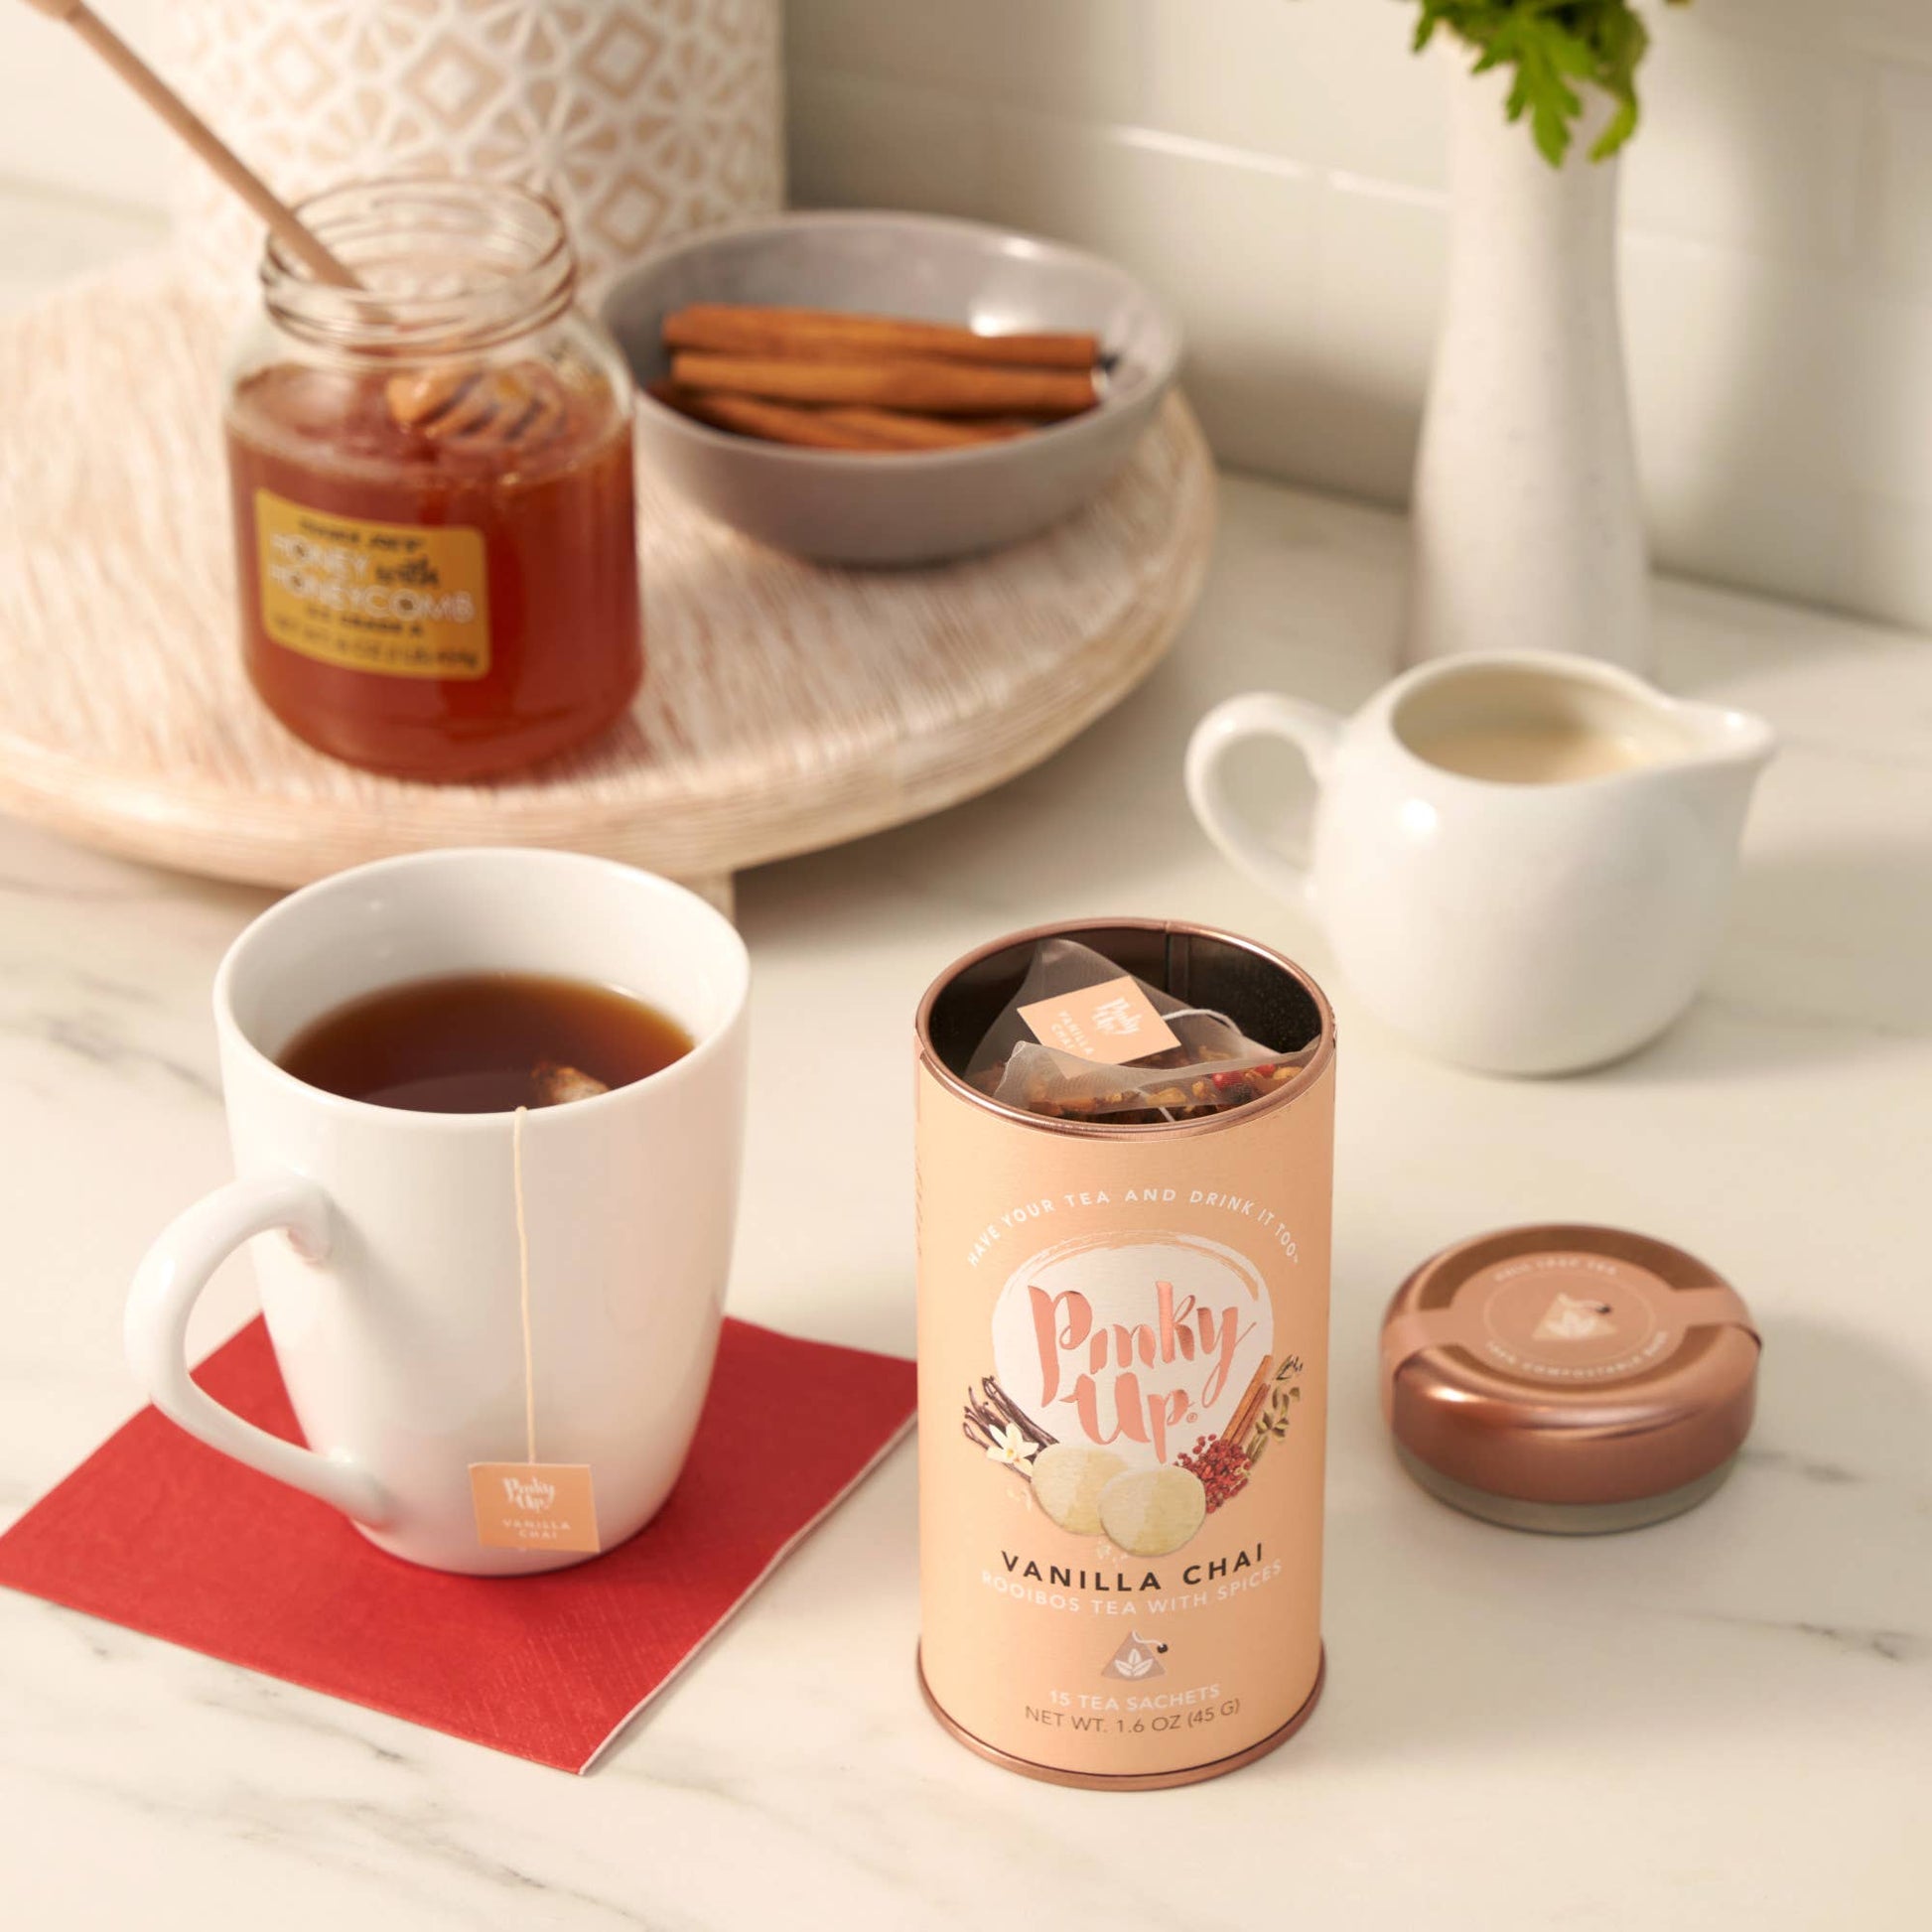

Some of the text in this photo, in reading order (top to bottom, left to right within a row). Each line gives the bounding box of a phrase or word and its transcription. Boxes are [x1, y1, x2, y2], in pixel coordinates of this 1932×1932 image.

[270, 533, 439, 588] HONEY with
[269, 563, 476, 623] HONEYCOMB
[1050, 1023, 1075, 1049] CHAI
[1058, 1010, 1095, 1054] VANILLA
[967, 1224, 1001, 1267] HAVE
[1001, 1199, 1055, 1228] YOUR
[1063, 1190, 1111, 1207] TEA
[1124, 1188, 1176, 1202] AND
[1189, 1190, 1255, 1215] DRINK
[1257, 1208, 1275, 1226] IT
[1028, 1281, 1258, 1408] Pinky
[501, 1518, 572, 1530] VANILLA
[981, 1559, 1283, 1615] ROOIBOS TEA WITH SPICES
[1001, 1543, 1262, 1591] VANILLA CHAI
[1025, 1698, 1240, 1733] NET WT. 1.6 OZ (45 G)
[1049, 1683, 1221, 1713] 15 TEA SACHETS
